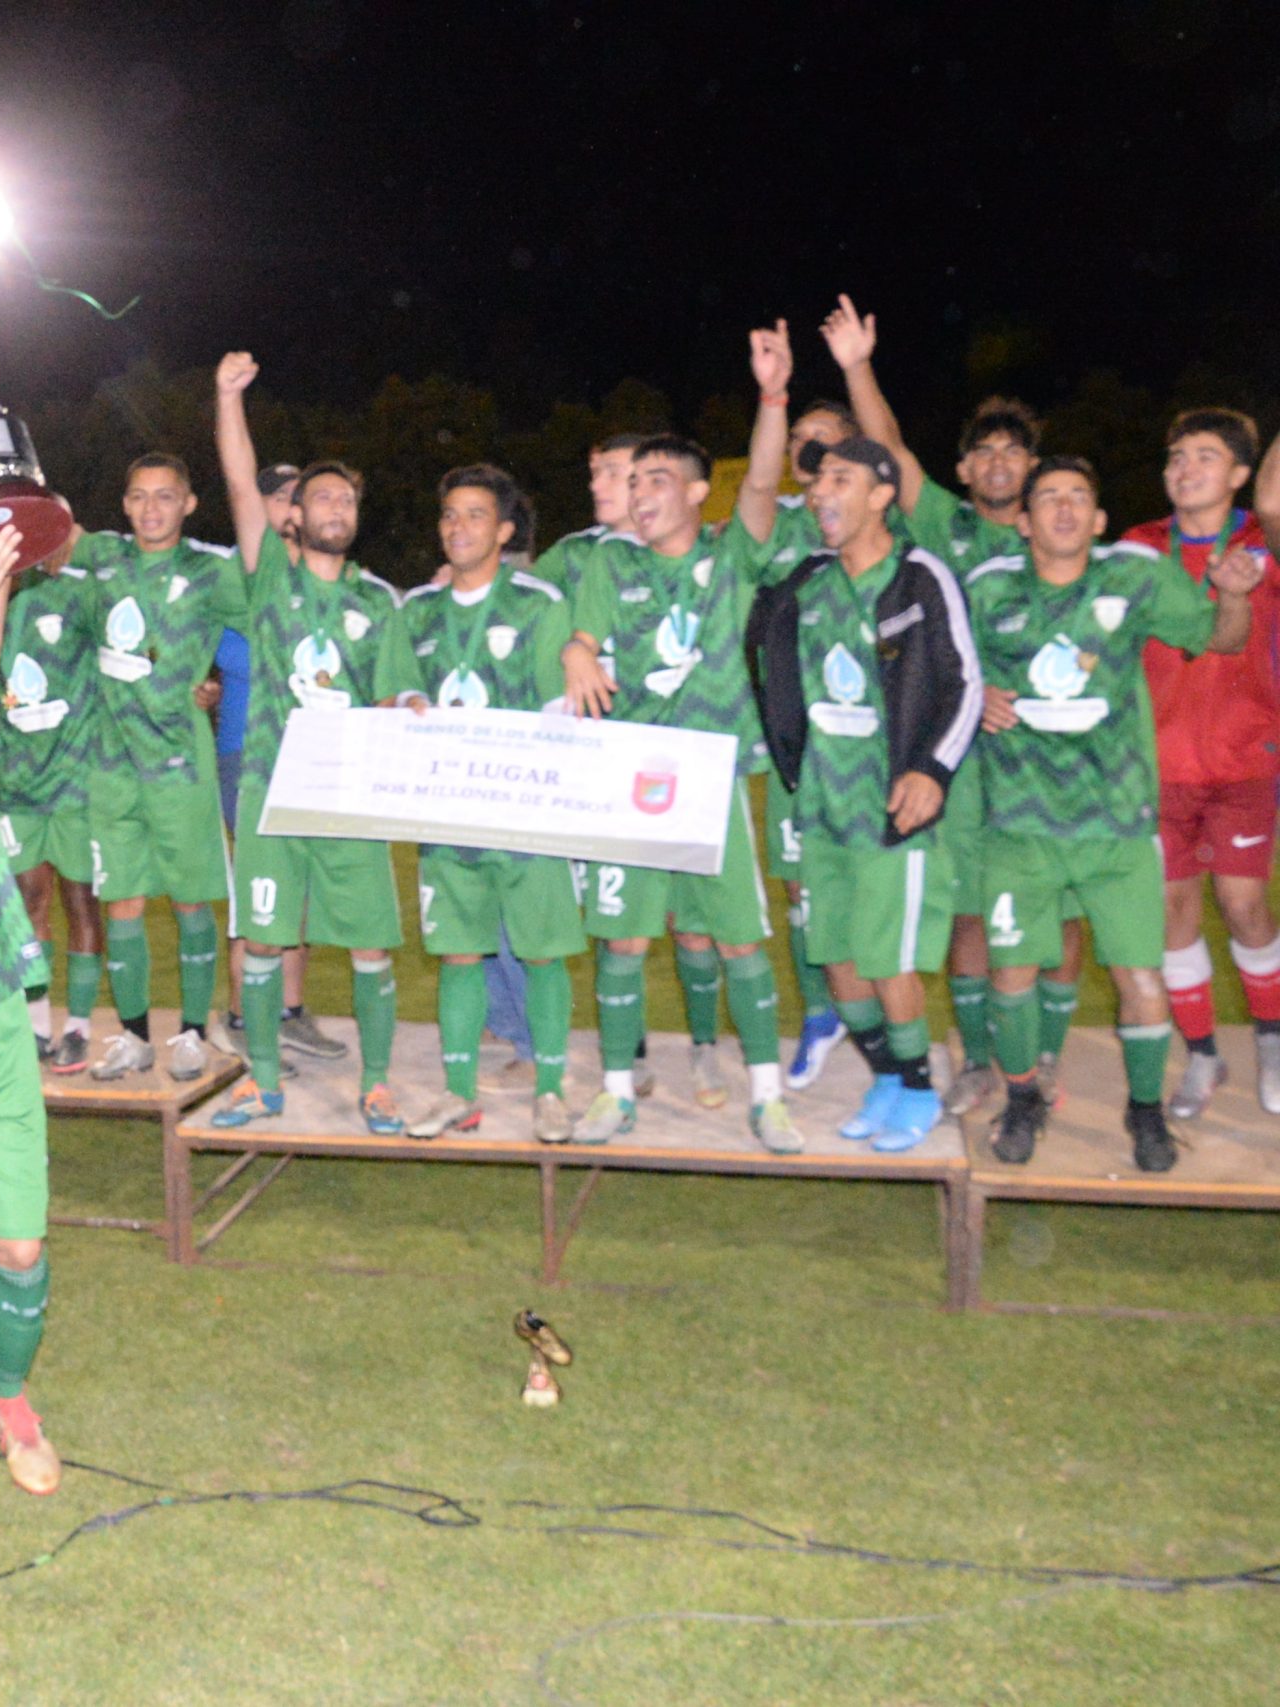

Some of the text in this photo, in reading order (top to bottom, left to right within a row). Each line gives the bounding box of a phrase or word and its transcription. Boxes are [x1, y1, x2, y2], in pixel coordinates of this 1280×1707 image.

[473, 725, 491, 737] DE
[497, 726, 526, 740] LOS
[467, 761, 561, 786] LUGAR
[372, 783, 614, 813] DOS MILLONES DE PESOS
[598, 865, 625, 905] 12
[990, 891, 1015, 932] 4
